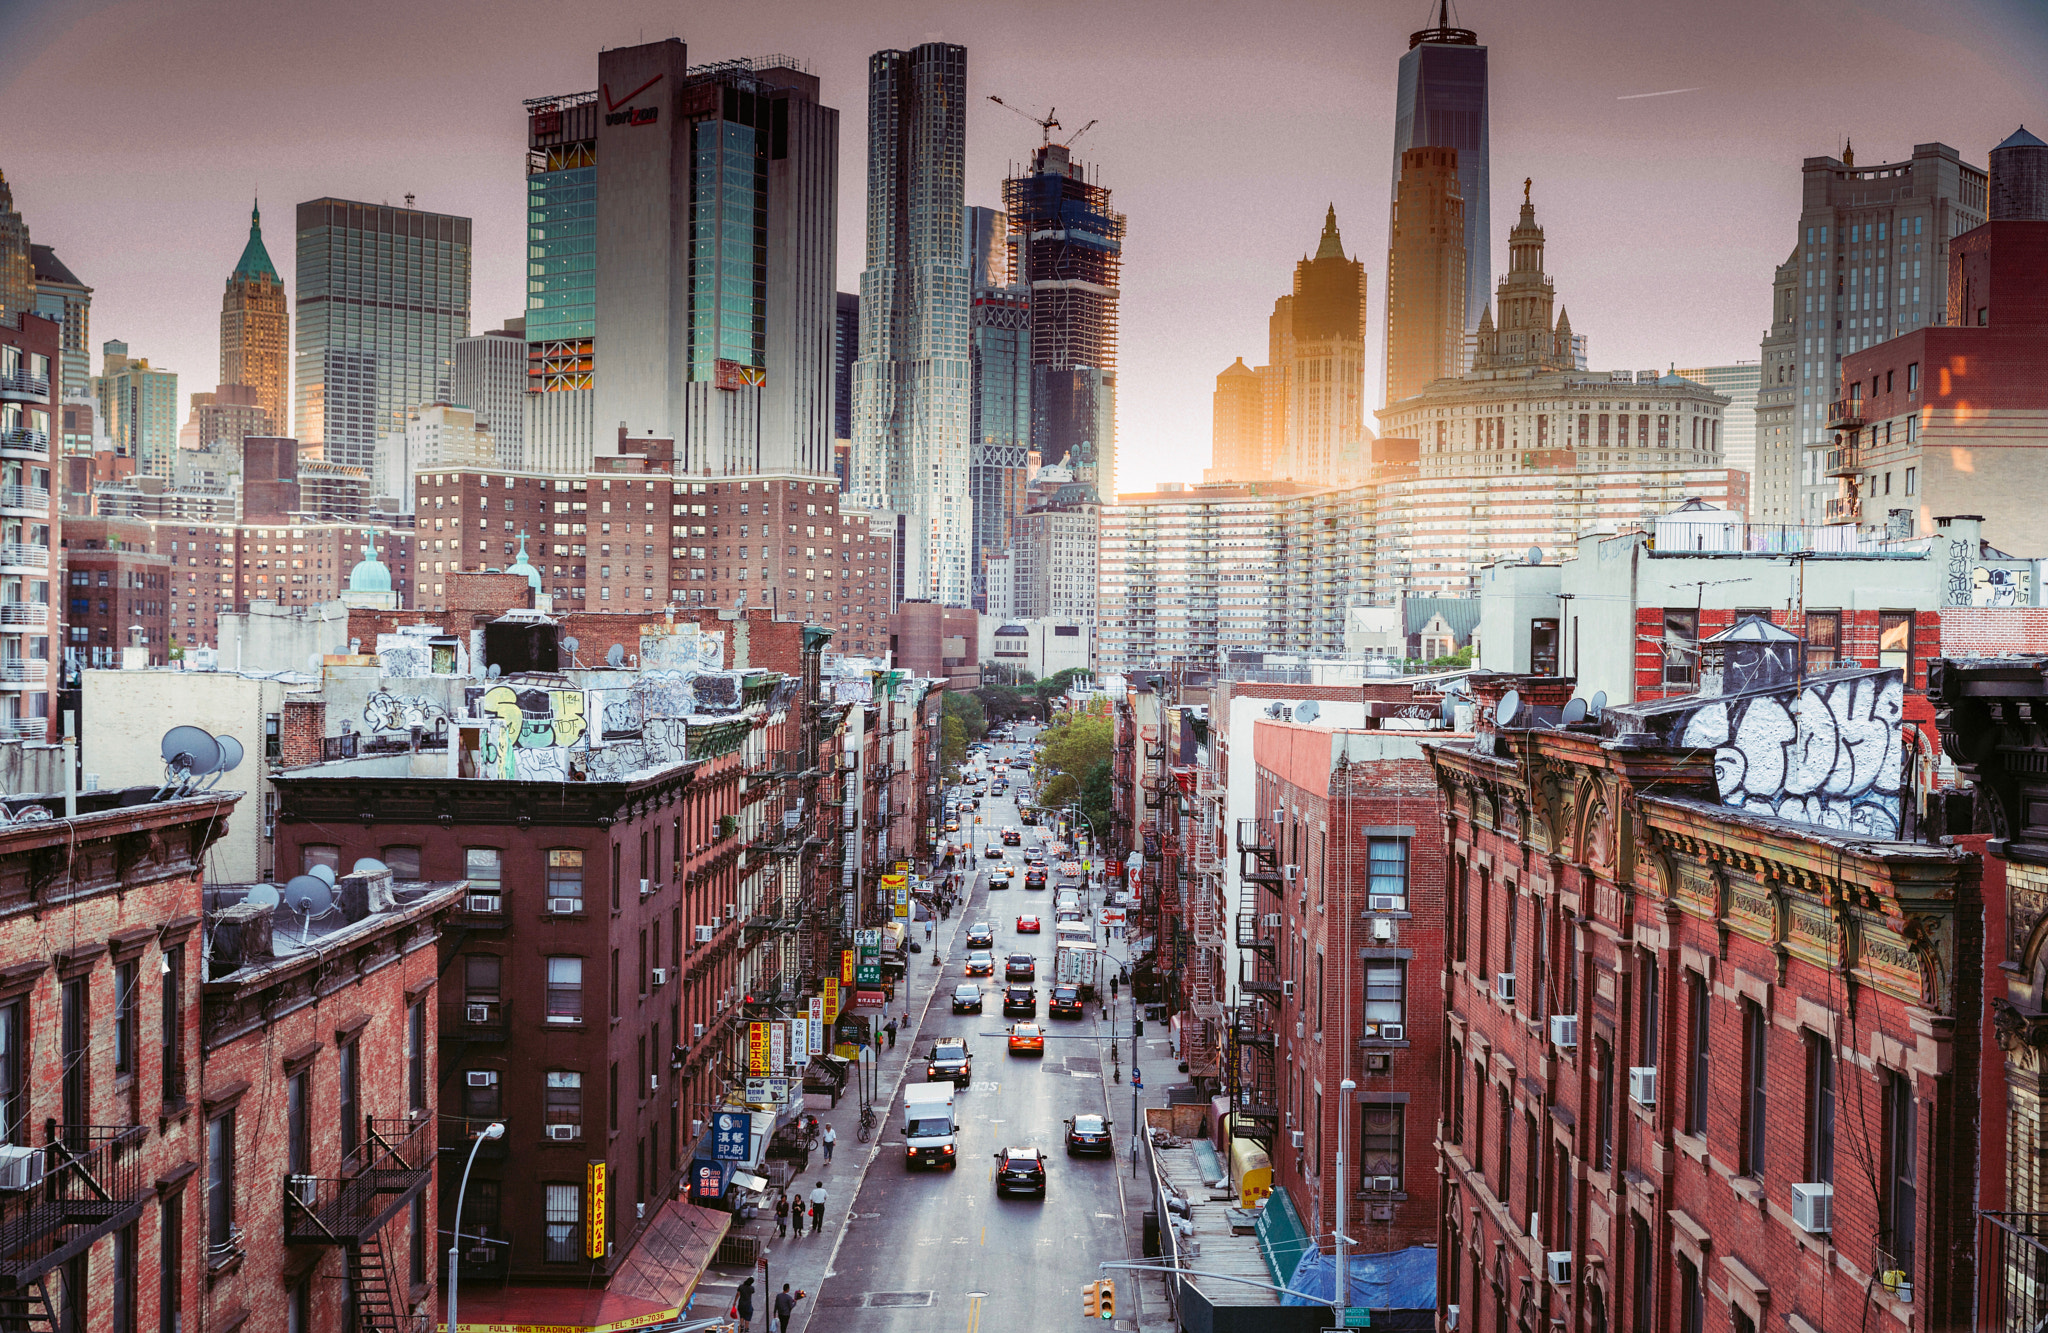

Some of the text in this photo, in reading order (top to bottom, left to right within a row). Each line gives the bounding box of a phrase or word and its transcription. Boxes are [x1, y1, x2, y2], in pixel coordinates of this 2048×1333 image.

[605, 106, 658, 126] verizon
[825, 978, 837, 1017] 環球網吧
[720, 1116, 743, 1129] Sino
[718, 1144, 744, 1155] 印刷
[610, 1312, 665, 1330] TEL: 349-7036
